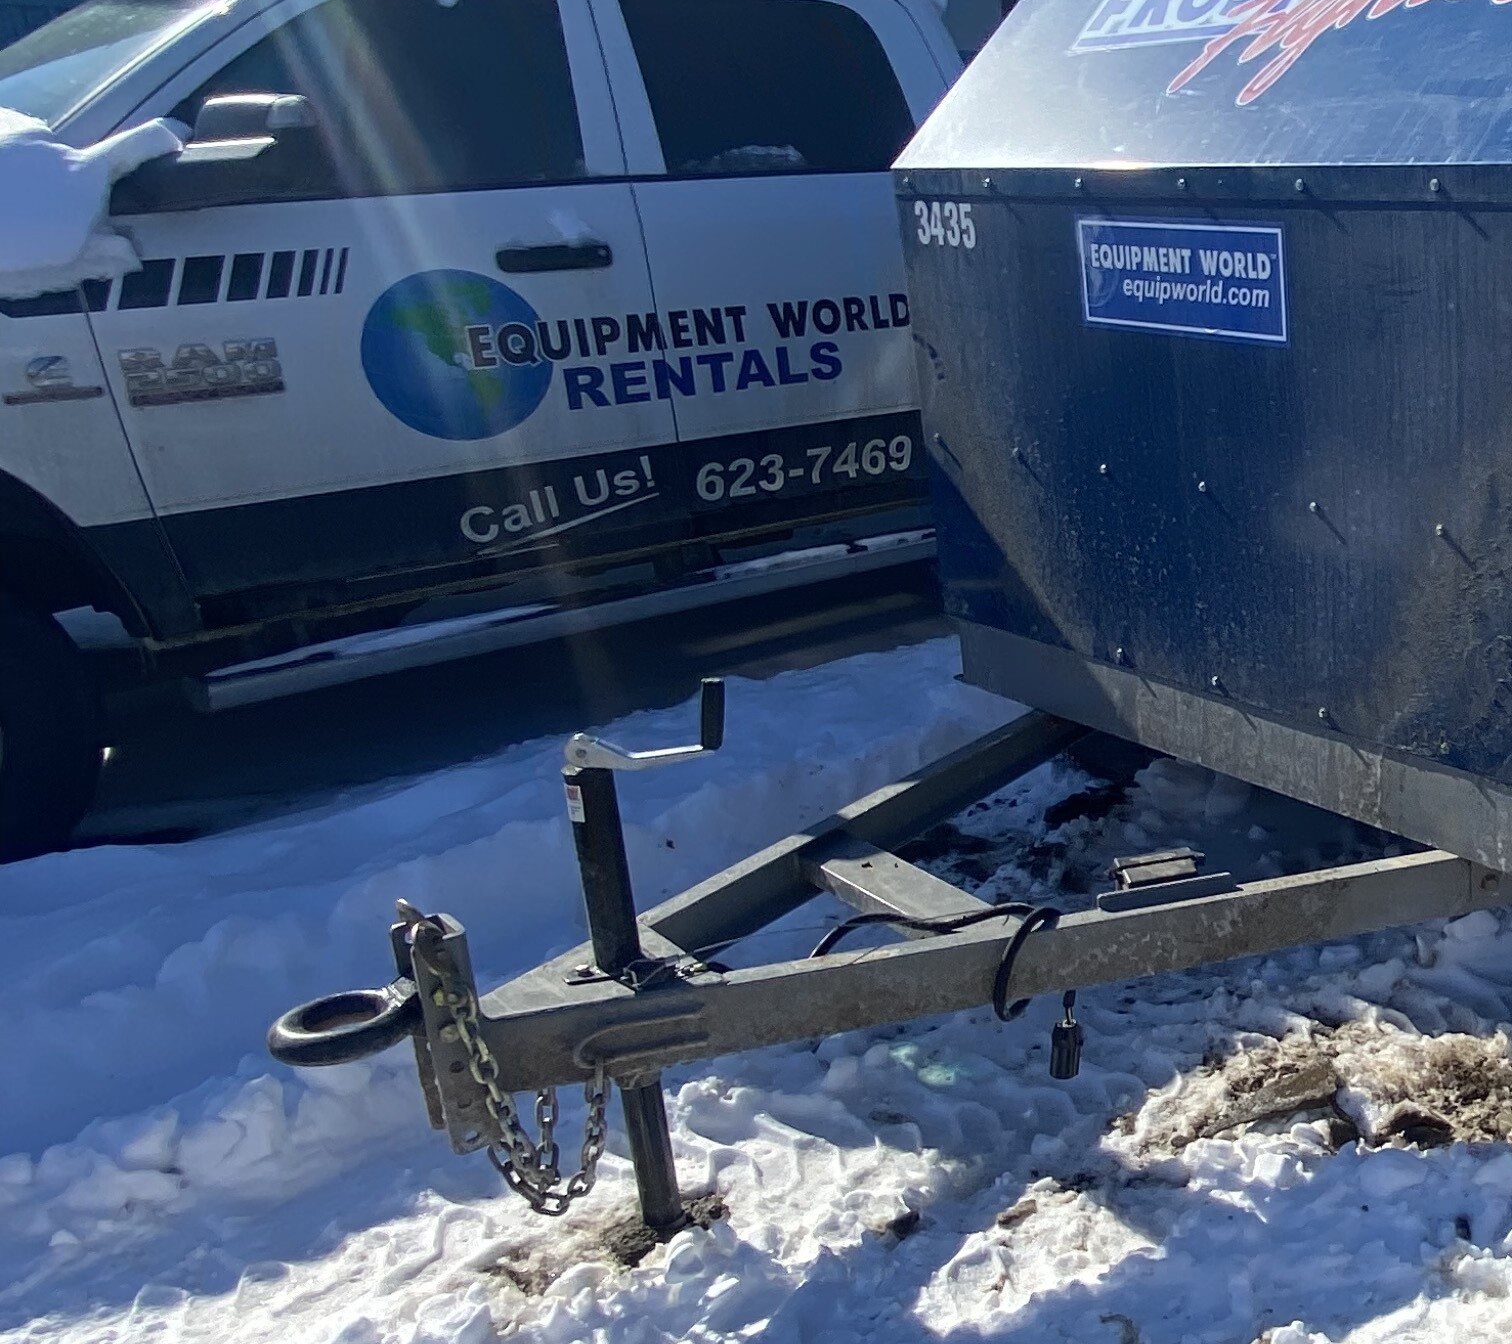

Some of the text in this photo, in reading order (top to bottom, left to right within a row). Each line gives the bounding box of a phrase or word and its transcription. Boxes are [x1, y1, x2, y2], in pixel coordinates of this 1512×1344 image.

[914, 200, 976, 249] 3435
[1090, 243, 1272, 280] EQUIPMENT WORLD
[1122, 276, 1270, 307] equipworld.com
[466, 293, 910, 369] EQUIPMENT WORLD
[563, 341, 842, 410] RENTALS
[460, 435, 912, 543] Call Us! 623-7469
